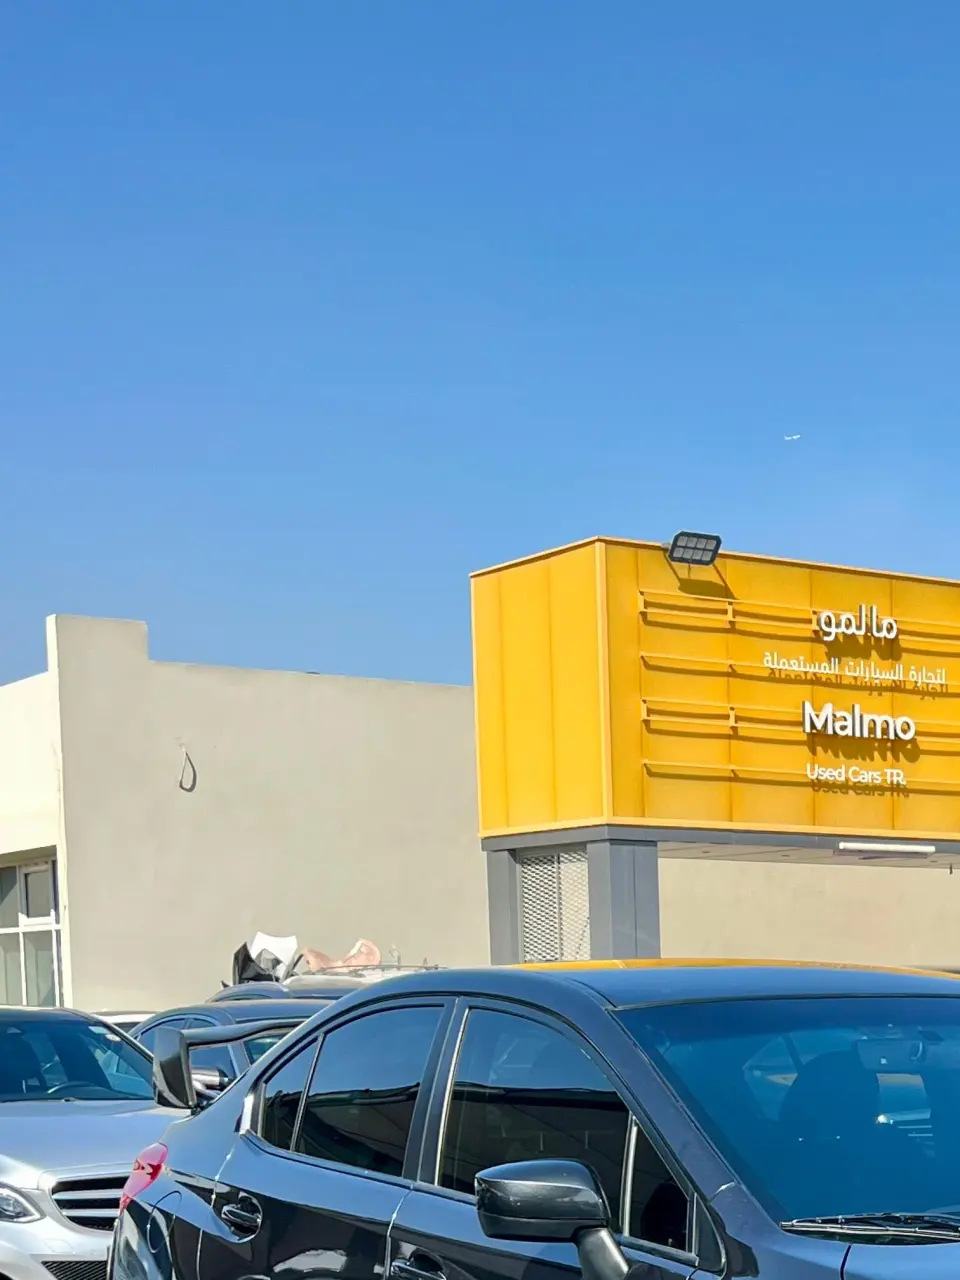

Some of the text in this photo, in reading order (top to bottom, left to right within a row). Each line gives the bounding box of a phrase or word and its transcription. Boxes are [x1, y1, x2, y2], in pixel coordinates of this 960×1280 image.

[819, 603, 897, 641] مالمو
[763, 652, 947, 686] لتجارة السيارات المستعملة
[802, 700, 916, 741] Malmo
[806, 763, 846, 782] Used
[848, 766, 882, 784] Cars
